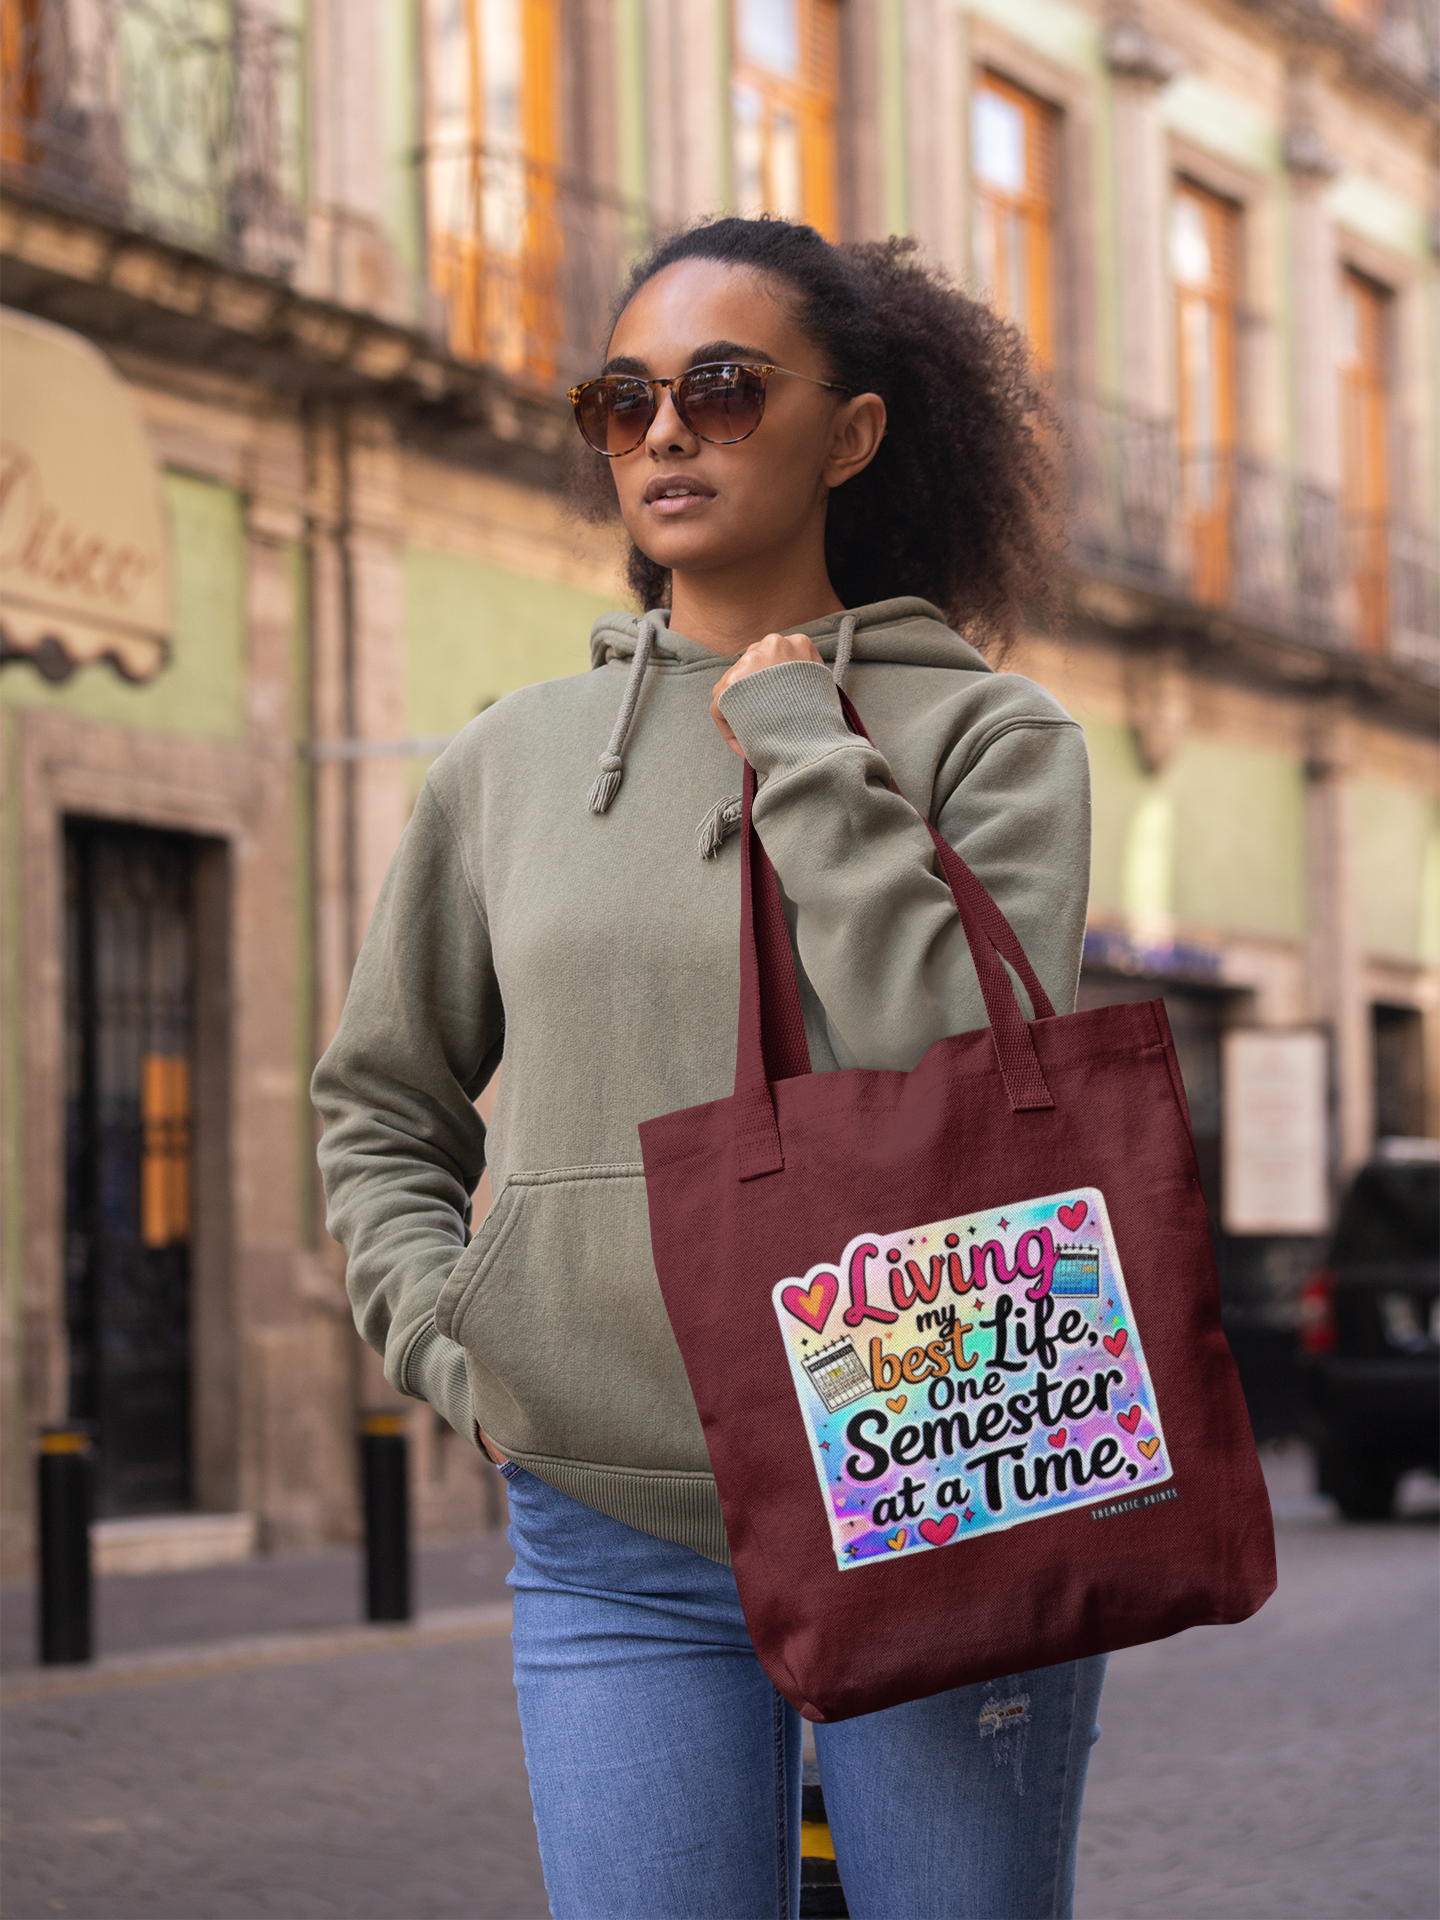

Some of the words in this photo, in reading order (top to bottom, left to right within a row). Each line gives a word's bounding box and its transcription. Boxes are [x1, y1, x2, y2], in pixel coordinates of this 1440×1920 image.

[843, 1226, 1060, 1327] Living
[916, 1304, 957, 1338] my
[870, 1321, 979, 1391] best
[980, 1294, 1099, 1371] Life,
[845, 1369, 1123, 1481] Semester
[928, 1372, 1006, 1411] One
[872, 1477, 926, 1527] at
[936, 1478, 970, 1509] a
[966, 1437, 1140, 1512] Time,
[1091, 1500, 1139, 1520] THEMATIC
[1143, 1487, 1178, 1506] PRINTS
